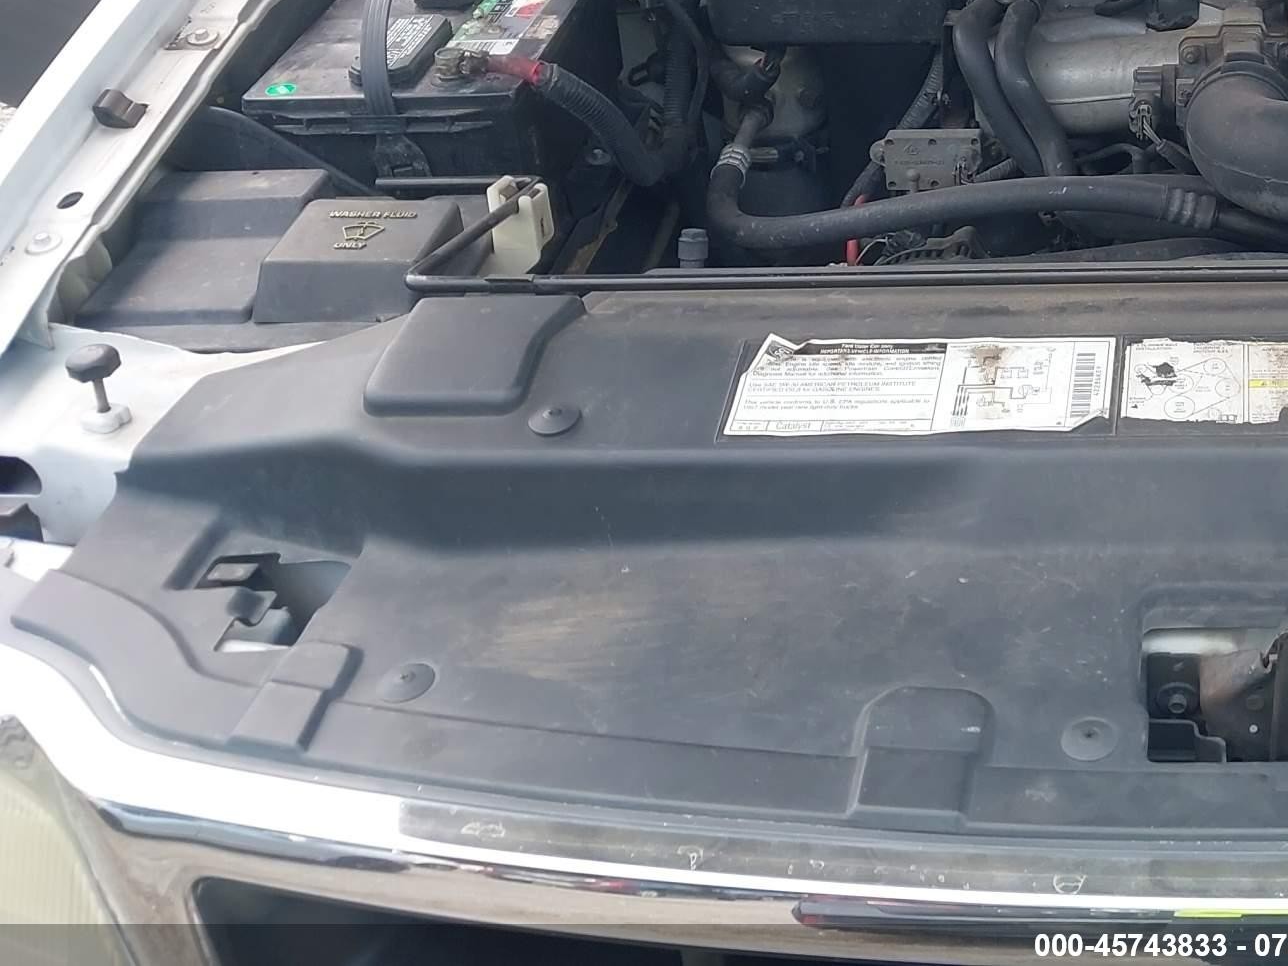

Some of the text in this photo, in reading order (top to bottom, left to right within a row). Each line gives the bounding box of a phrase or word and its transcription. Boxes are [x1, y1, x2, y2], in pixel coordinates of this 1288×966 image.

[328, 210, 418, 219] WASHER FLUID
[333, 242, 367, 250] ONLY
[775, 421, 811, 430] Catalyst
